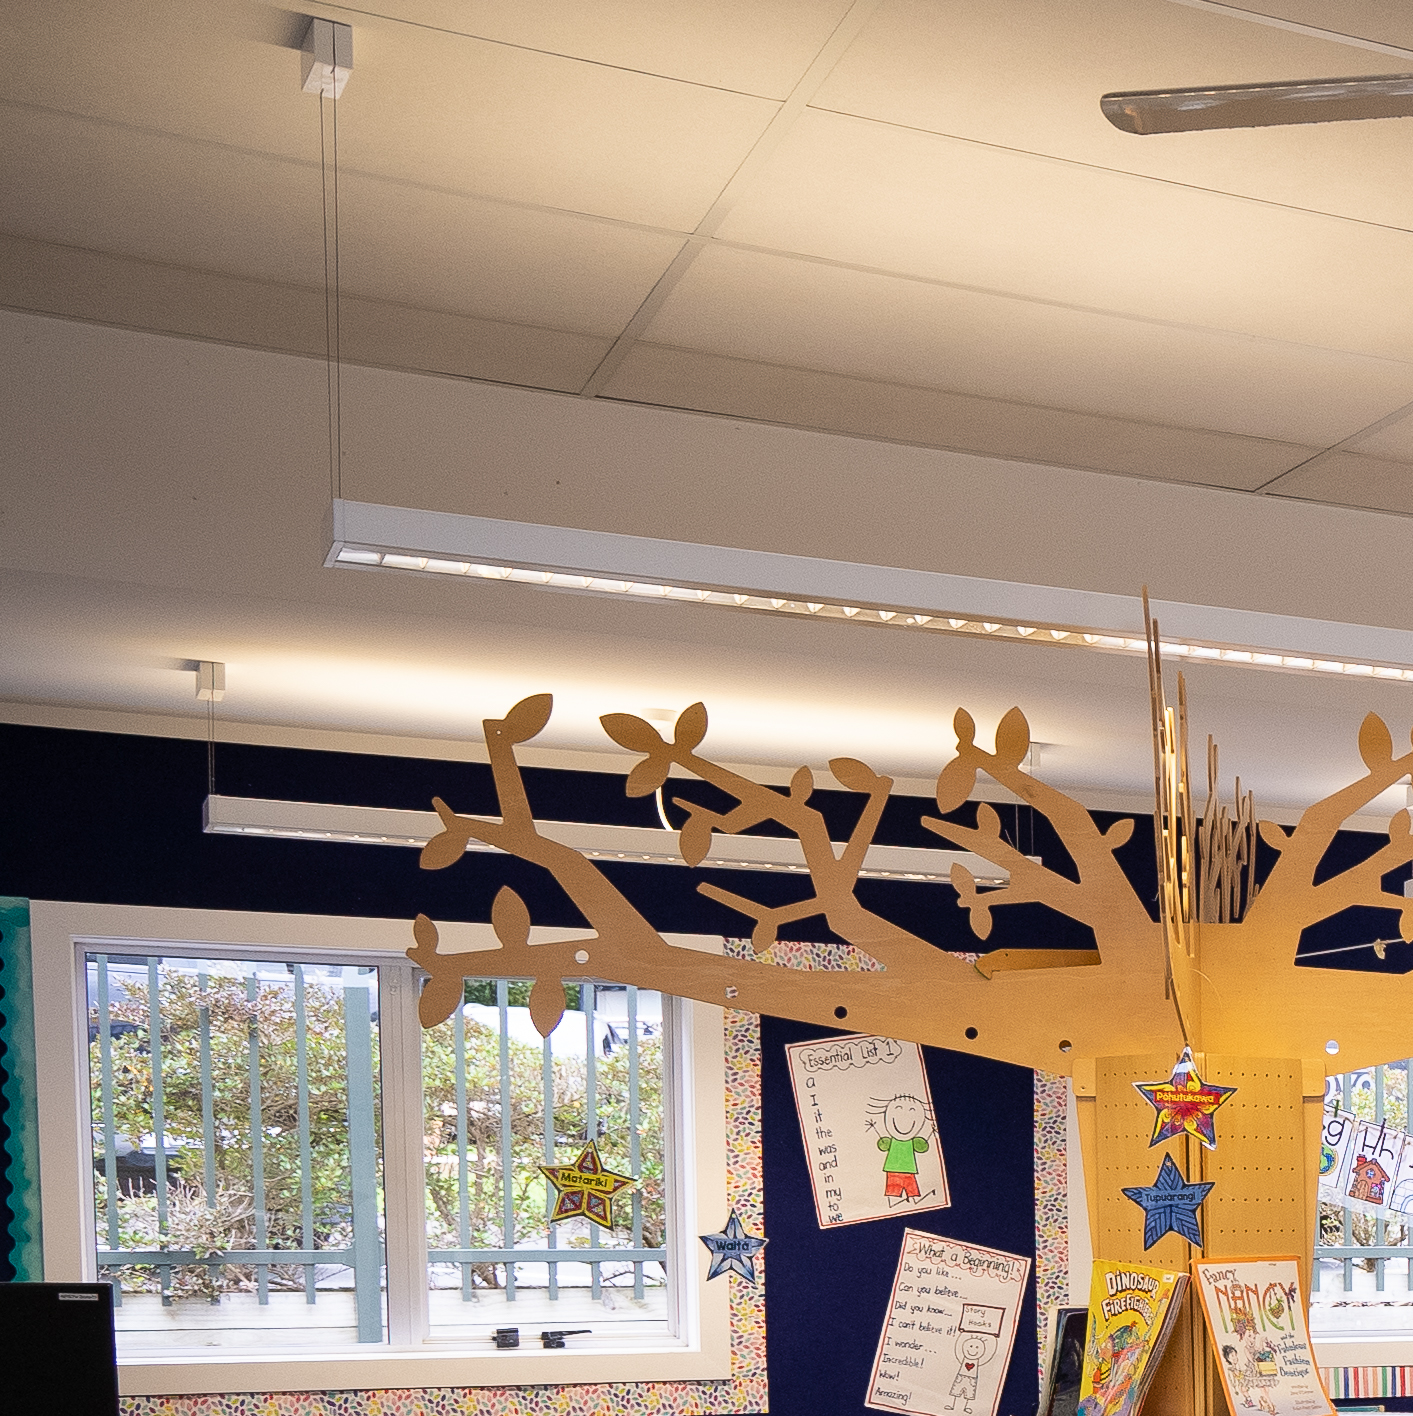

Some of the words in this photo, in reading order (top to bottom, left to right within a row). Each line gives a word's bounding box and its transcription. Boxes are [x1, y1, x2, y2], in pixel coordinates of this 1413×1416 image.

[808, 1051, 854, 1068] Essential
[861, 1046, 877, 1061] List
[886, 1041, 893, 1057] 1
[815, 1127, 832, 1139] the
[818, 1143, 837, 1155] was
[819, 1155, 838, 1169] and
[561, 1172, 607, 1188] Matariki
[826, 1187, 841, 1200] my
[918, 1241, 944, 1258] What
[951, 1253, 958, 1263] a
[962, 1251, 1015, 1277] Beginning!
[1202, 1268, 1237, 1286] Fancy
[1105, 1270, 1160, 1301] DINOSAUR
[1214, 1282, 1296, 1334] NANCY
[882, 1354, 923, 1369] Incredible!
[875, 1387, 912, 1403] Amazing!
